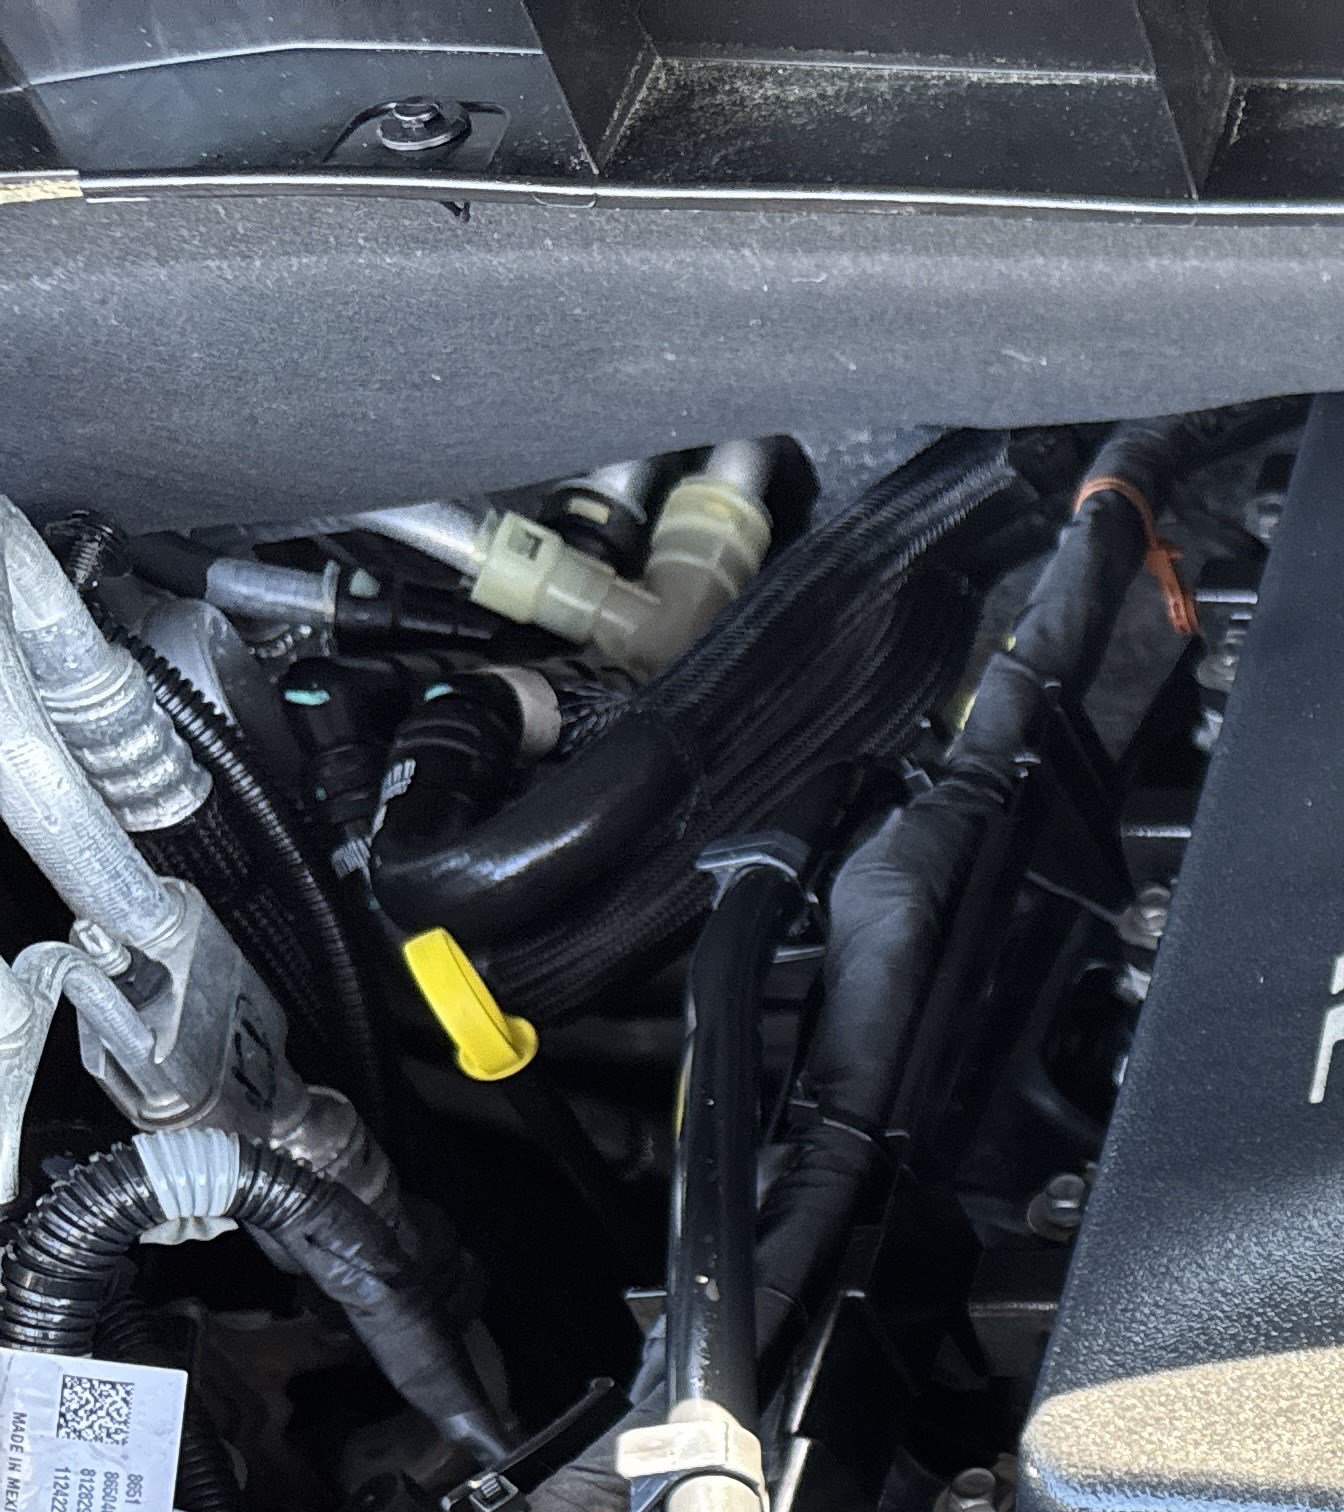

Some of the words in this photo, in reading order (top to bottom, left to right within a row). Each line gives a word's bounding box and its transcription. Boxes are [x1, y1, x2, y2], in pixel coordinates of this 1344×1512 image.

[10, 1411, 28, 1453] MADE
[8, 1456, 22, 1473] IN
[125, 1473, 144, 1506] 8651
